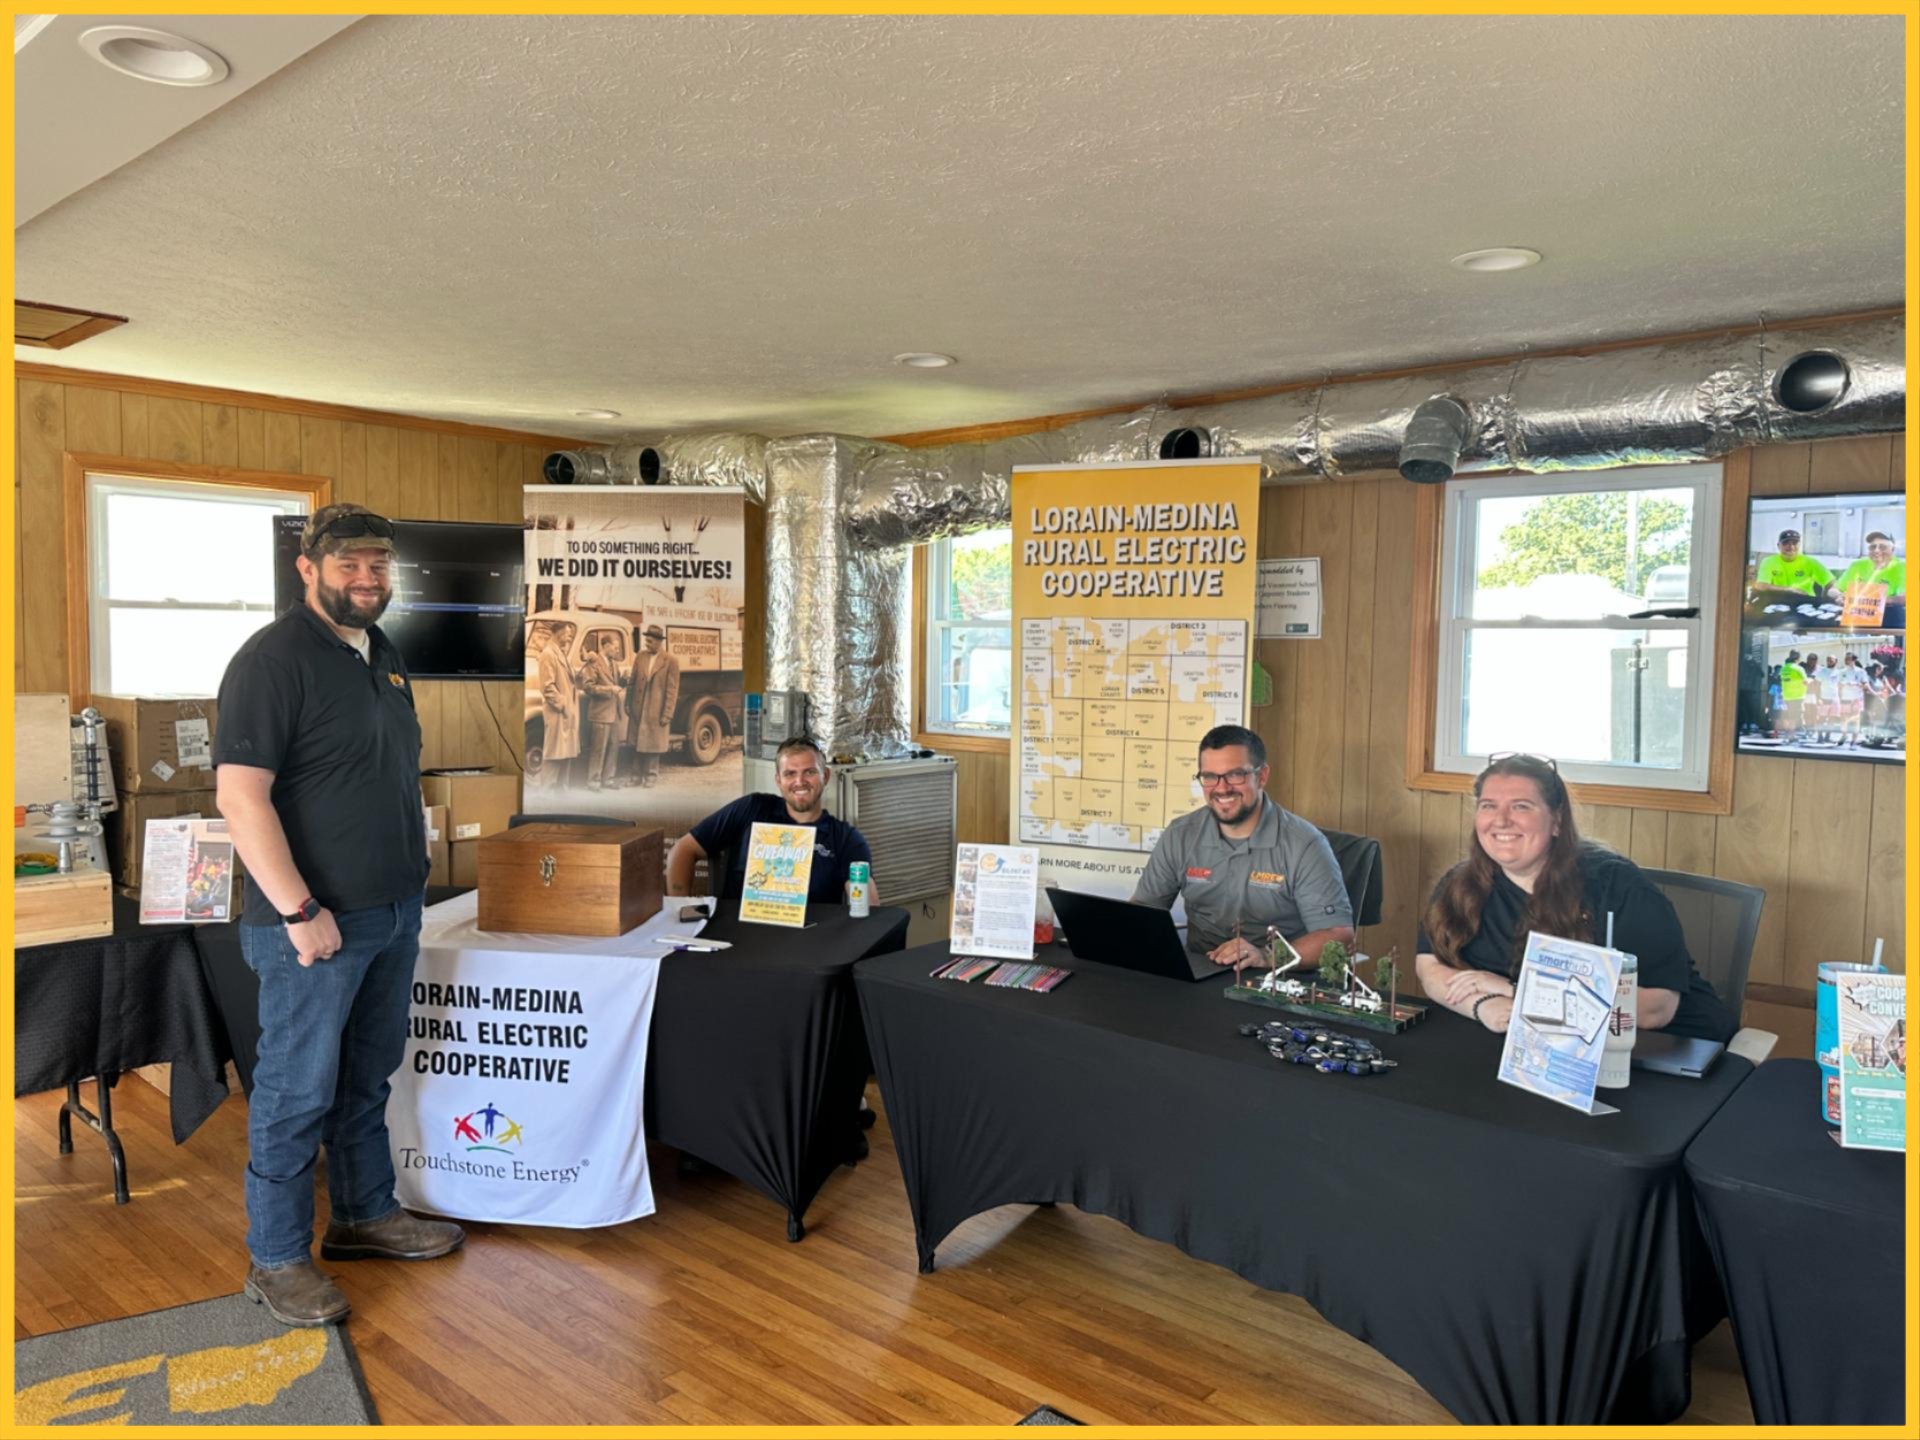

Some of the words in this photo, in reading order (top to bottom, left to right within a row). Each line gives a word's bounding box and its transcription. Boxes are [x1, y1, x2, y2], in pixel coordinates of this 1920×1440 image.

[1031, 502, 1238, 533] LORAIN-MEDINA
[566, 541, 580, 554] TO
[582, 541, 597, 554] DO
[599, 541, 660, 555] SOMETHING
[1023, 538, 1107, 566] RURAL
[1114, 535, 1246, 565] ELECTRIC
[538, 558, 564, 576] WE
[568, 559, 599, 577] DID
[602, 559, 620, 578] IT
[623, 559, 732, 579] OURSELVES!
[1041, 569, 1223, 597] COOPERATIVE
[1131, 687, 1159, 695] DISTRICT
[1080, 809, 1105, 817] DISTRICT
[755, 843, 809, 864] GIVEAWAY
[1055, 859, 1081, 870] MORE
[1083, 862, 1117, 873] ABOUT
[1119, 864, 1132, 874] US
[1539, 953, 1589, 974] smarthub
[409, 981, 583, 1015] ORAIN-MEDINA
[478, 1021, 589, 1049] ELECTRIC
[413, 1049, 570, 1084] COOPERATIVE
[400, 1147, 506, 1179] Touchstone
